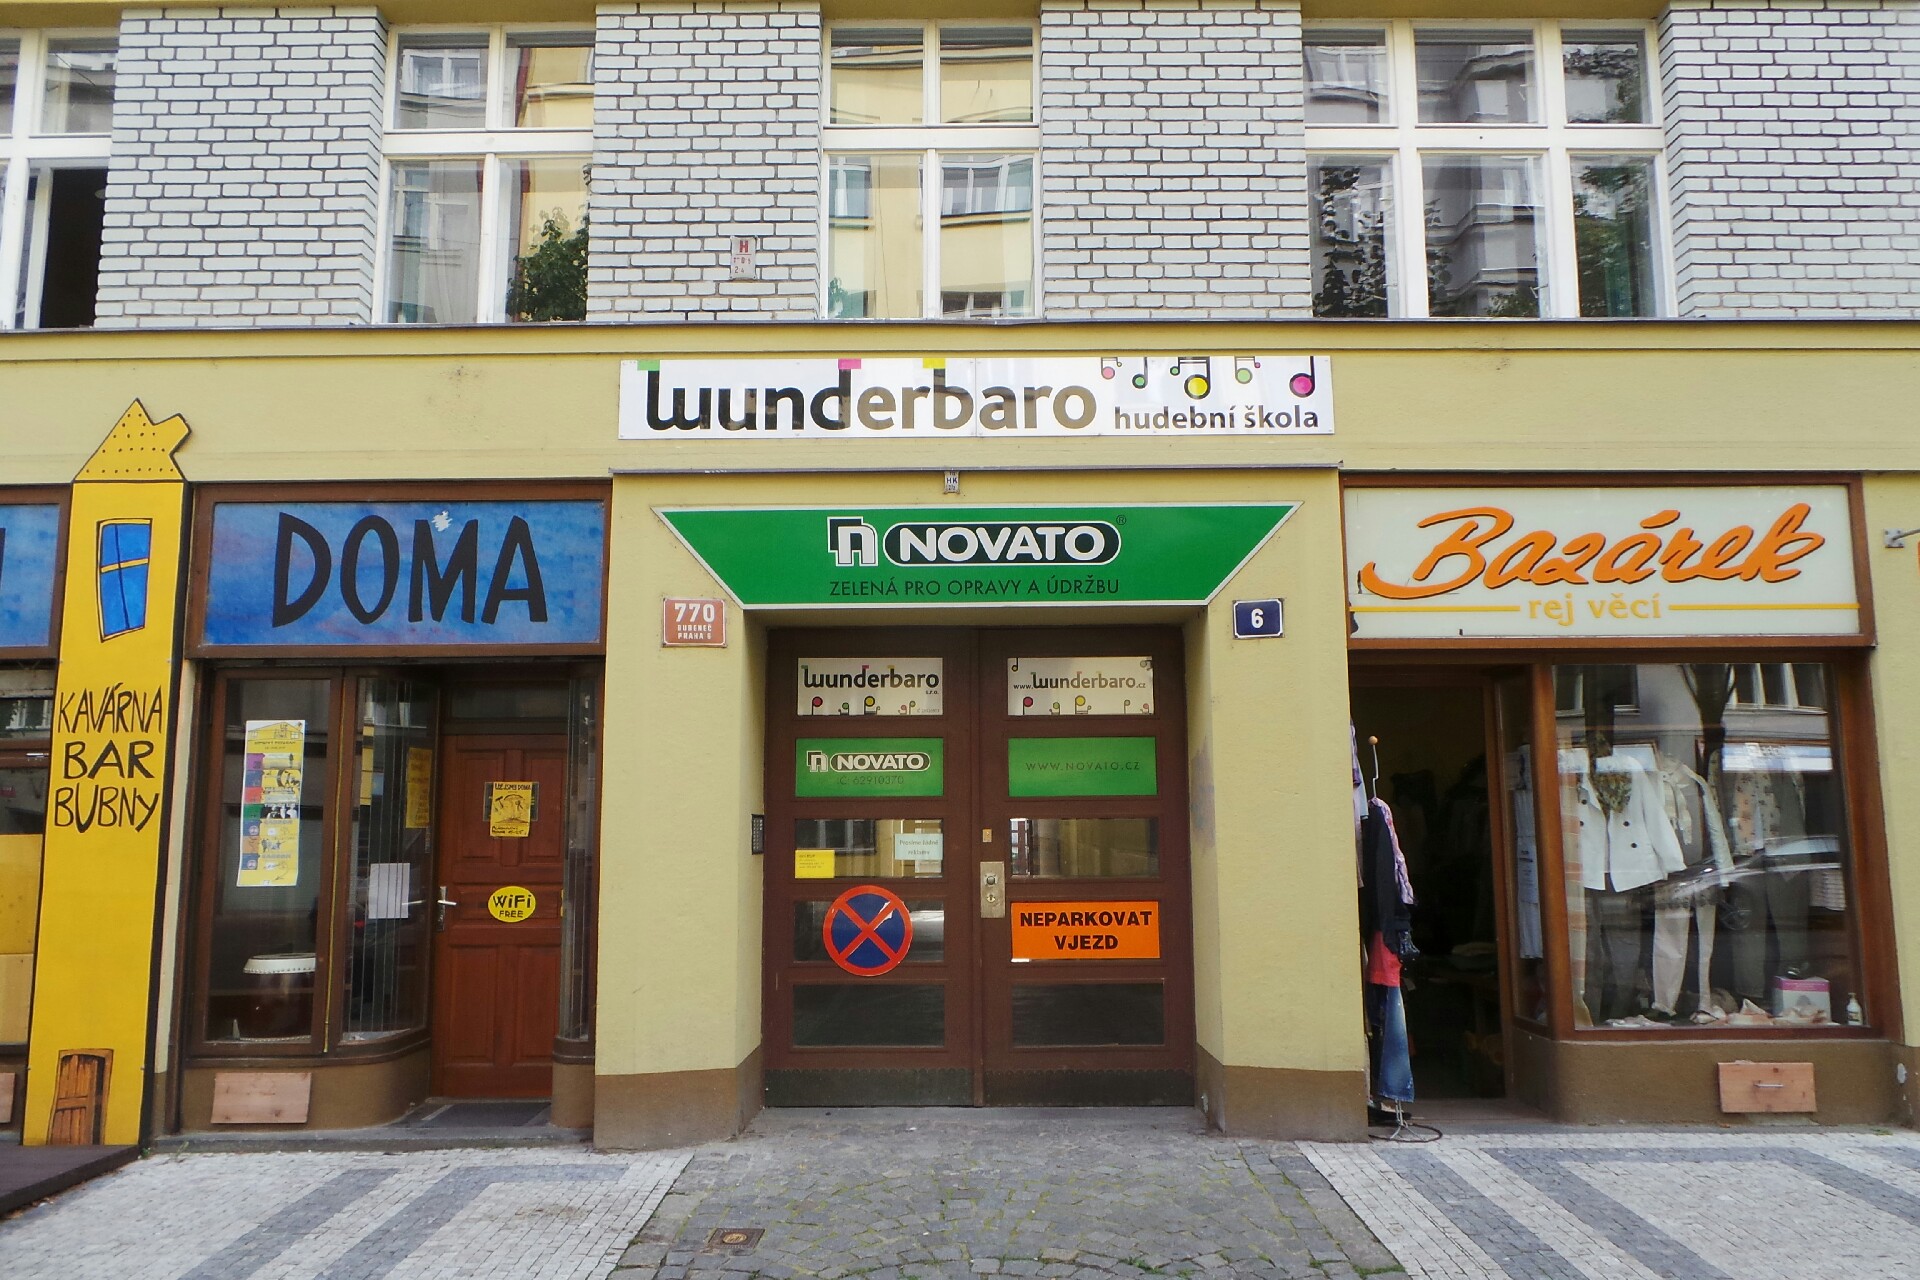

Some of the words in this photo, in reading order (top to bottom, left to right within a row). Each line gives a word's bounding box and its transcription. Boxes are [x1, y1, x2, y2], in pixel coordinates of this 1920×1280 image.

[739, 240, 749, 253] H
[637, 358, 1098, 432] wunderbaro
[1114, 405, 1237, 430] hudební
[1243, 404, 1319, 429] škola
[899, 525, 1106, 562] NOVATO
[1359, 502, 1826, 600] Bazárek
[272, 511, 548, 628] DOMA
[829, 576, 899, 597] ZELENÁ
[904, 580, 941, 596] PRO
[947, 579, 1022, 596] OPRAVY
[1026, 579, 1041, 595] A
[1046, 573, 1120, 595] ÚDRŽBU
[674, 602, 715, 623] 770
[1251, 608, 1264, 629] 6
[1529, 595, 1574, 626] rej
[1588, 592, 1662, 620] věcí
[677, 632, 704, 640] PRAHA
[801, 665, 940, 688] wunderbaro
[58, 682, 163, 734] KAVÁRNA
[64, 739, 155, 780] BAR
[836, 754, 925, 771] NOVATO
[54, 782, 160, 834] BUBNY
[492, 894, 531, 908] WiFi
[499, 910, 524, 918] FREE
[1020, 911, 1152, 927] NEPARKOVAT
[1054, 935, 1119, 950] VJEZD
